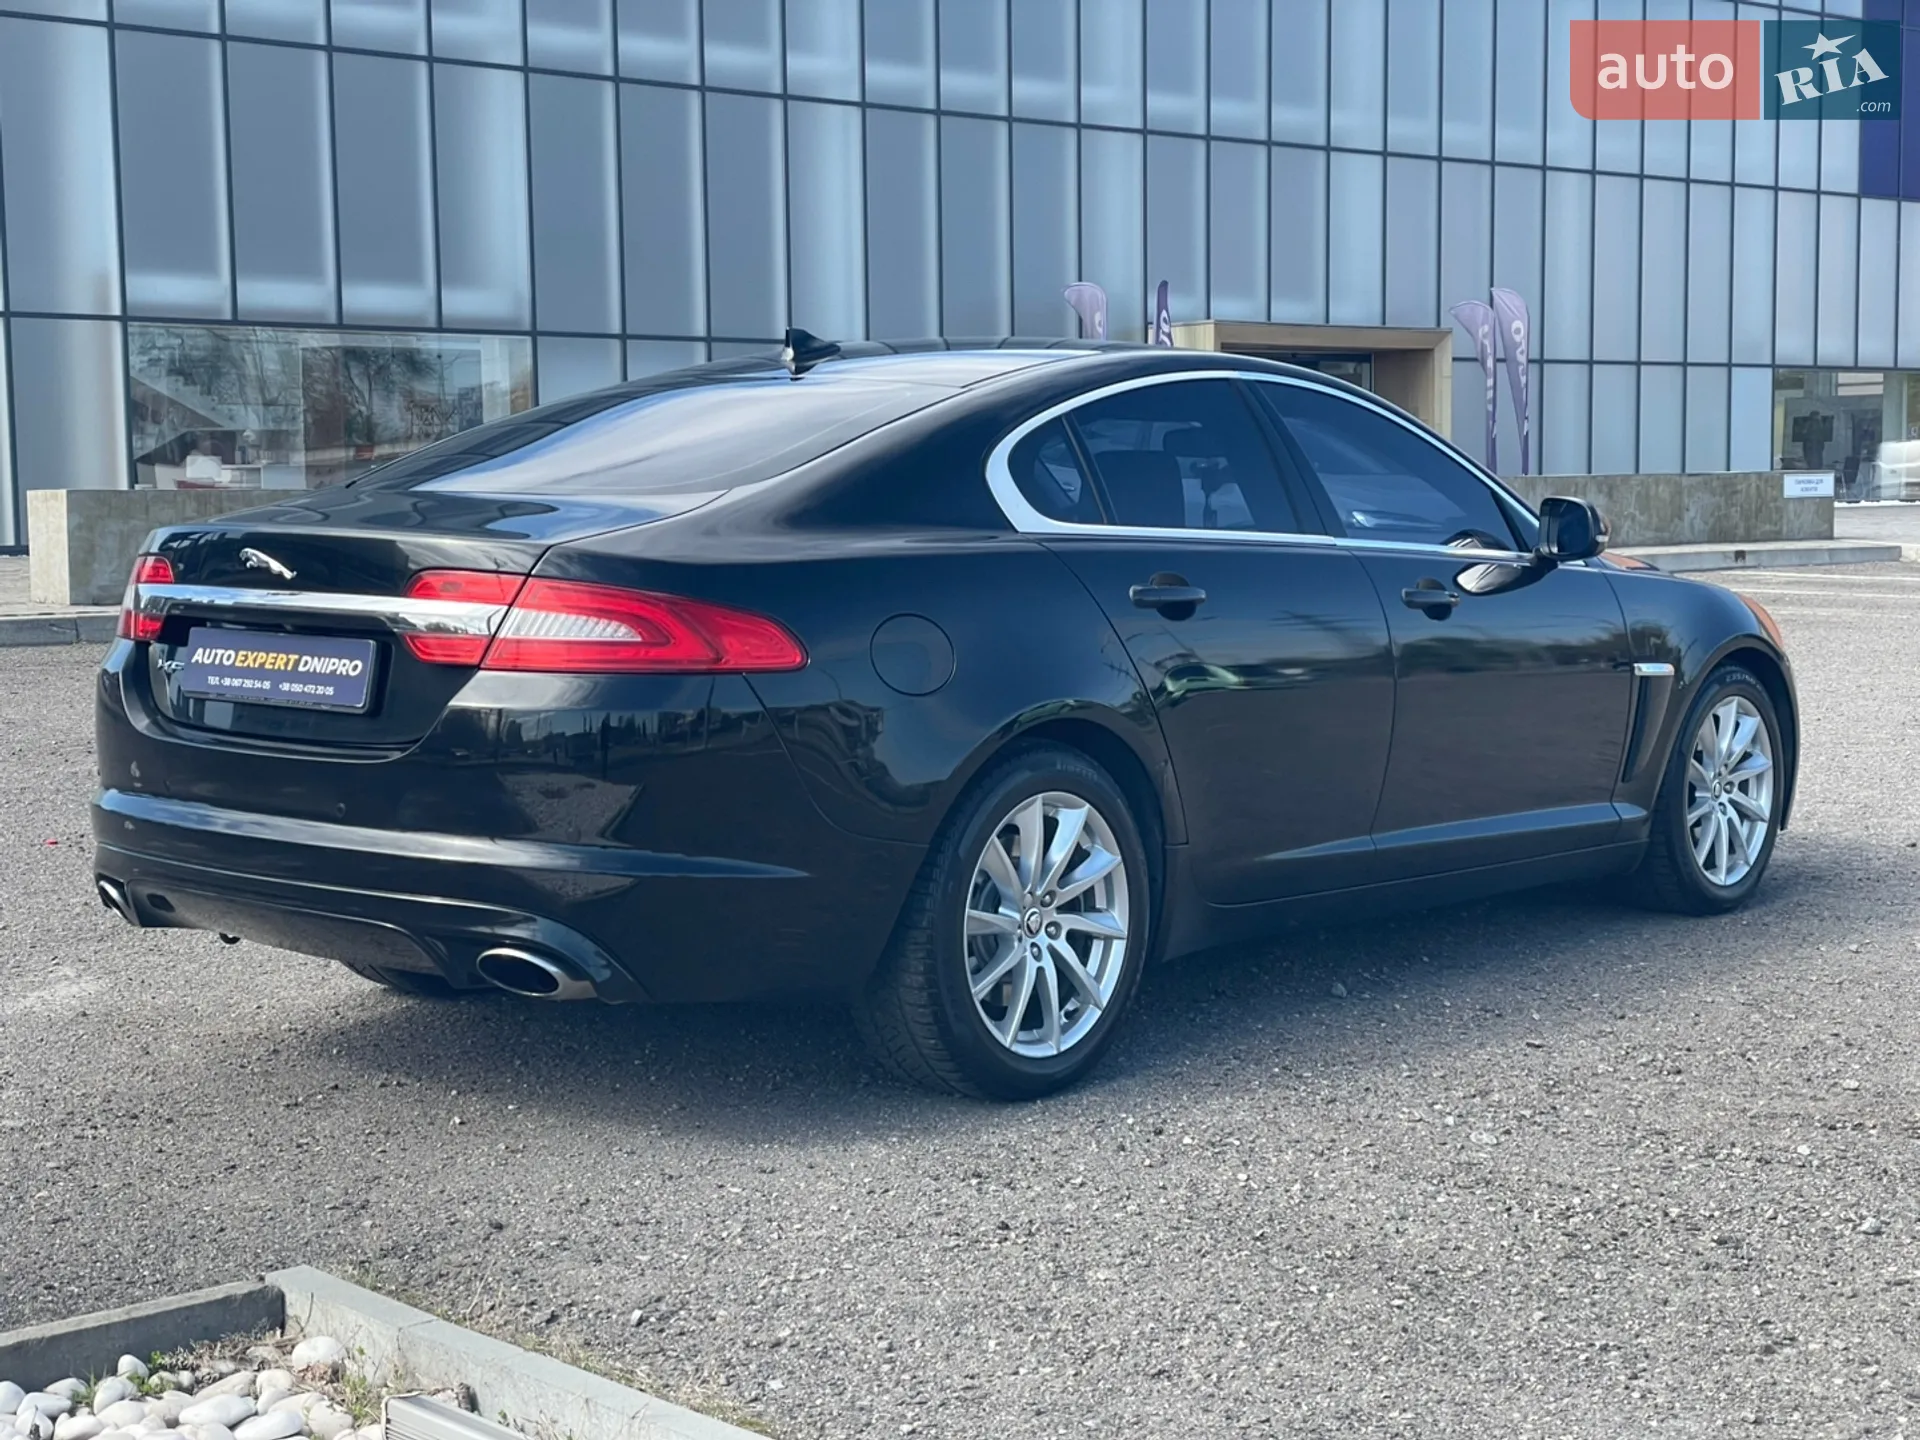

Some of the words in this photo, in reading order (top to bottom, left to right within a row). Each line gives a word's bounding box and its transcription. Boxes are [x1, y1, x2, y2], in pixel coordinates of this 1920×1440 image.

[191, 647, 235, 665] AUTO
[235, 650, 299, 671] EXPERT
[298, 655, 363, 676] DNIPRO
